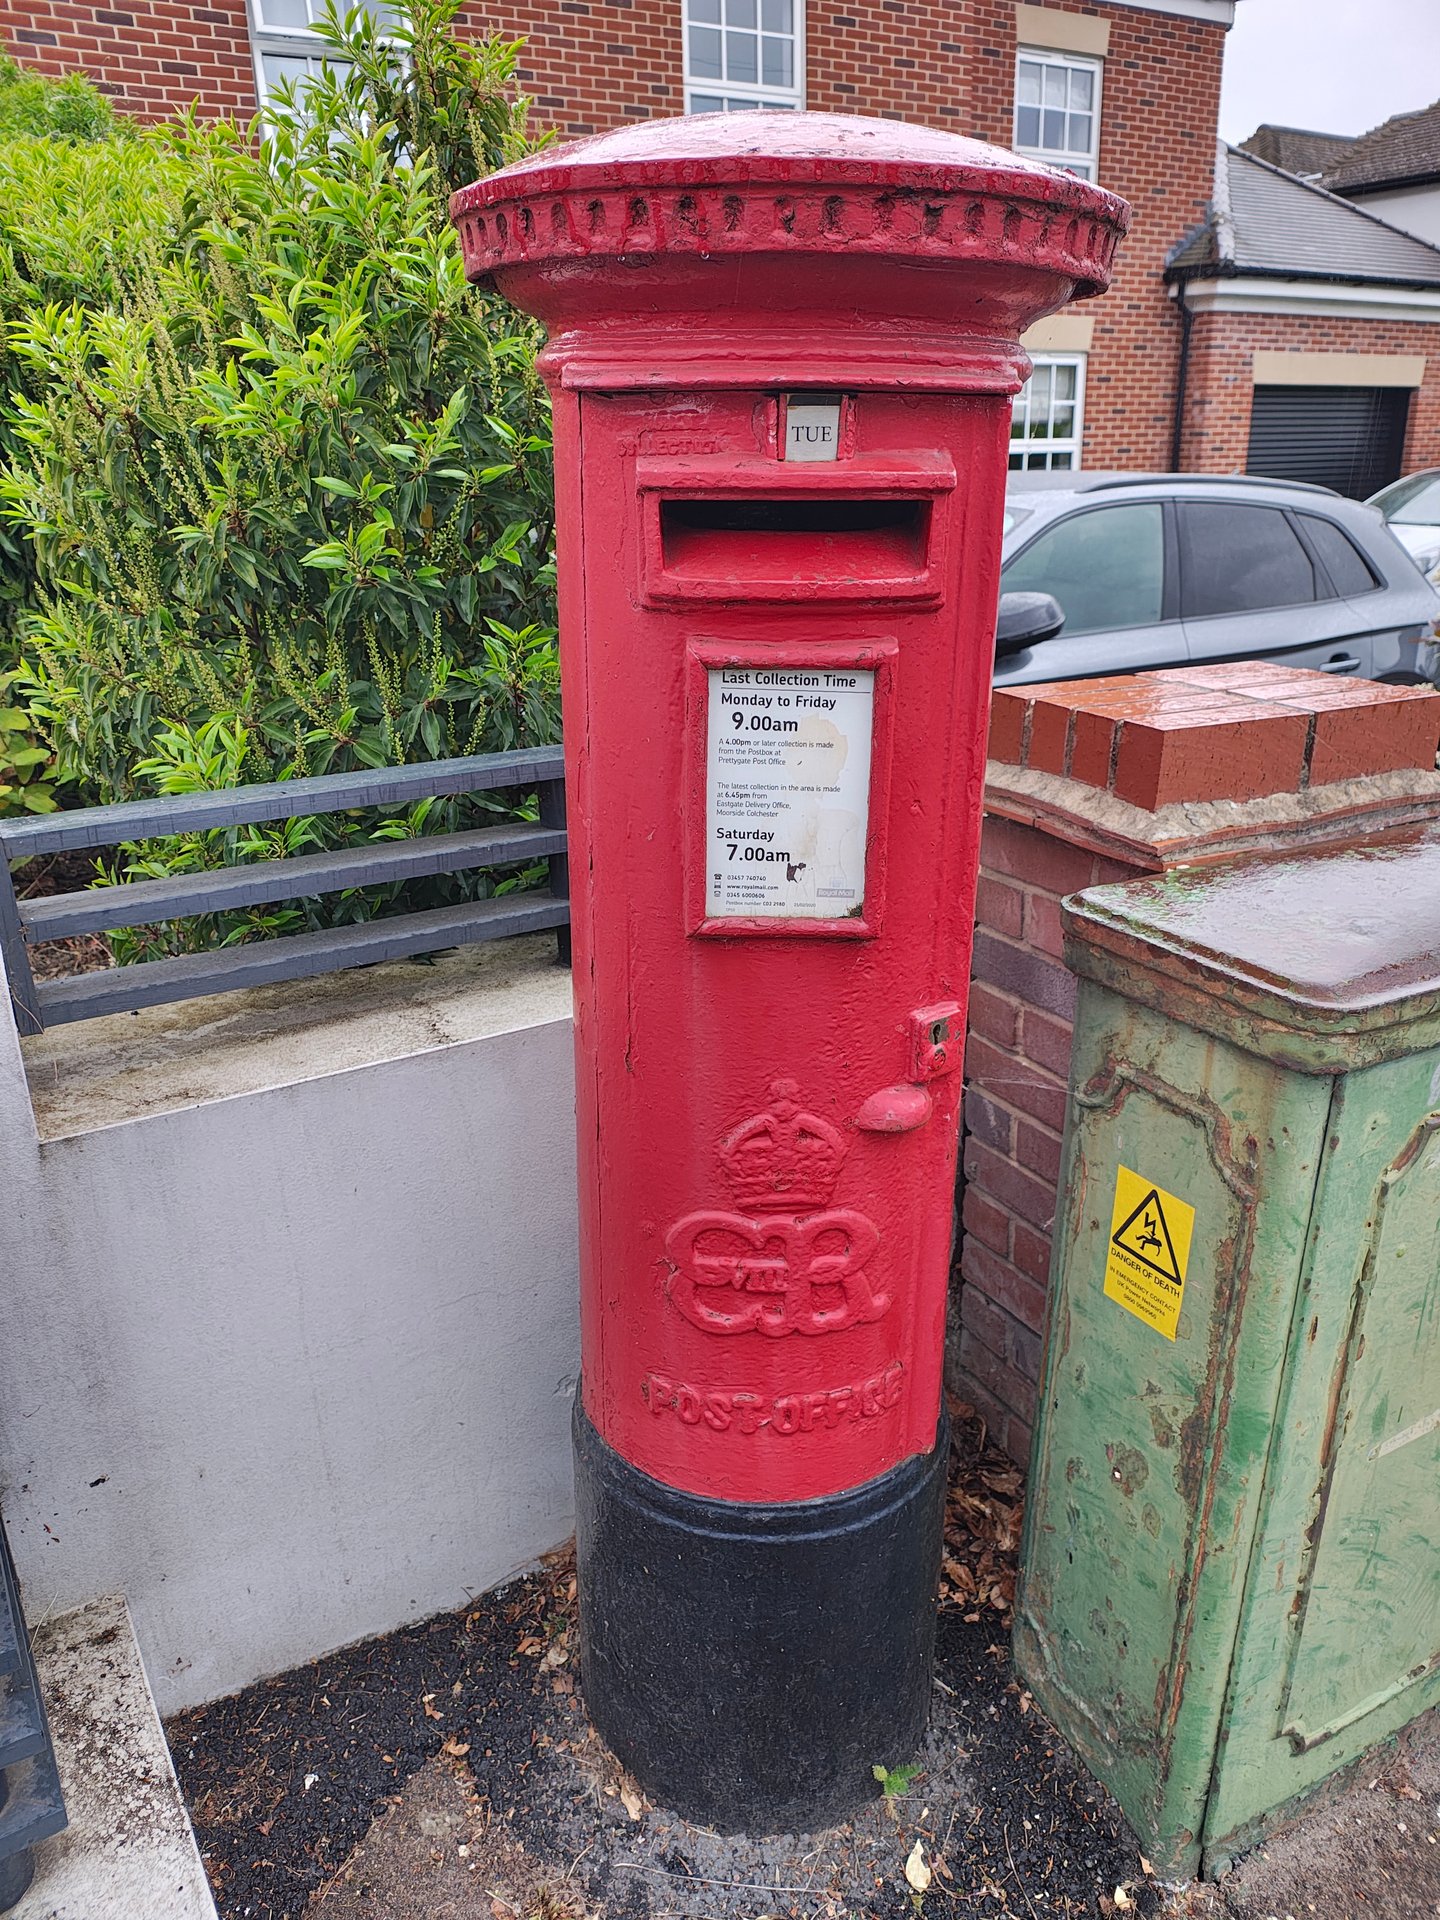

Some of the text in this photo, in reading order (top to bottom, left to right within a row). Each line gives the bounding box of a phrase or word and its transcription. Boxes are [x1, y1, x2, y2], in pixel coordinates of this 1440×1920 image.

[791, 425, 832, 442] TUE
[722, 671, 857, 687] Last Collection Time
[721, 692, 837, 711] Monday to Friday
[731, 711, 798, 732] 9.00am
[725, 738, 751, 747] 4.00pm
[761, 739, 776, 747] later
[777, 740, 808, 748] collection
[815, 741, 835, 749] made
[748, 748, 773, 756] Postbox
[718, 757, 786, 766] Prettygate Post Office
[731, 782, 749, 790] latest
[749, 783, 779, 791] collection
[822, 785, 841, 793] made
[724, 791, 751, 800] 6.45pm
[716, 800, 744, 809] Eastgate
[745, 800, 771, 809] Delivery
[746, 810, 779, 818] Colchester
[716, 827, 775, 842] Saturday
[726, 843, 791, 862] 7.00am
[1111, 1247, 1180, 1298] DANGER OF DEATH
[1116, 1269, 1149, 1295] EMERGENCY
[1149, 1293, 1176, 1313] CONTACT
[647, 1361, 903, 1434] POST OFFICE
